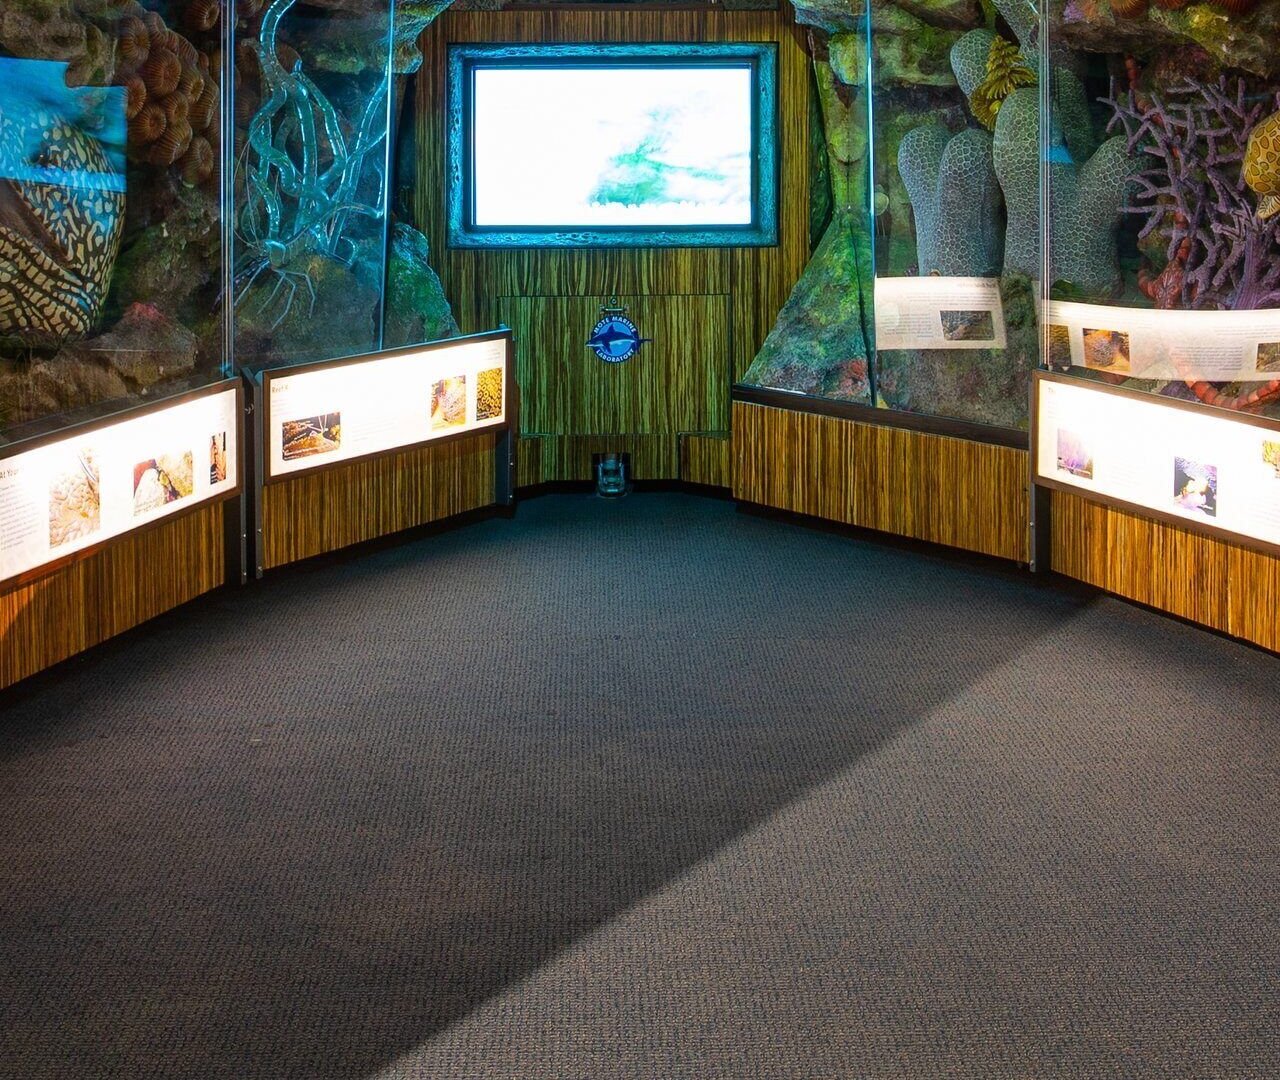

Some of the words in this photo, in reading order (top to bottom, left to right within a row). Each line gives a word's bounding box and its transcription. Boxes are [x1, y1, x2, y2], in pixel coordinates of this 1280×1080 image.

[593, 317, 610, 333] MOTE
[612, 316, 637, 333] MARINE
[596, 348, 634, 363] LABORATORY
